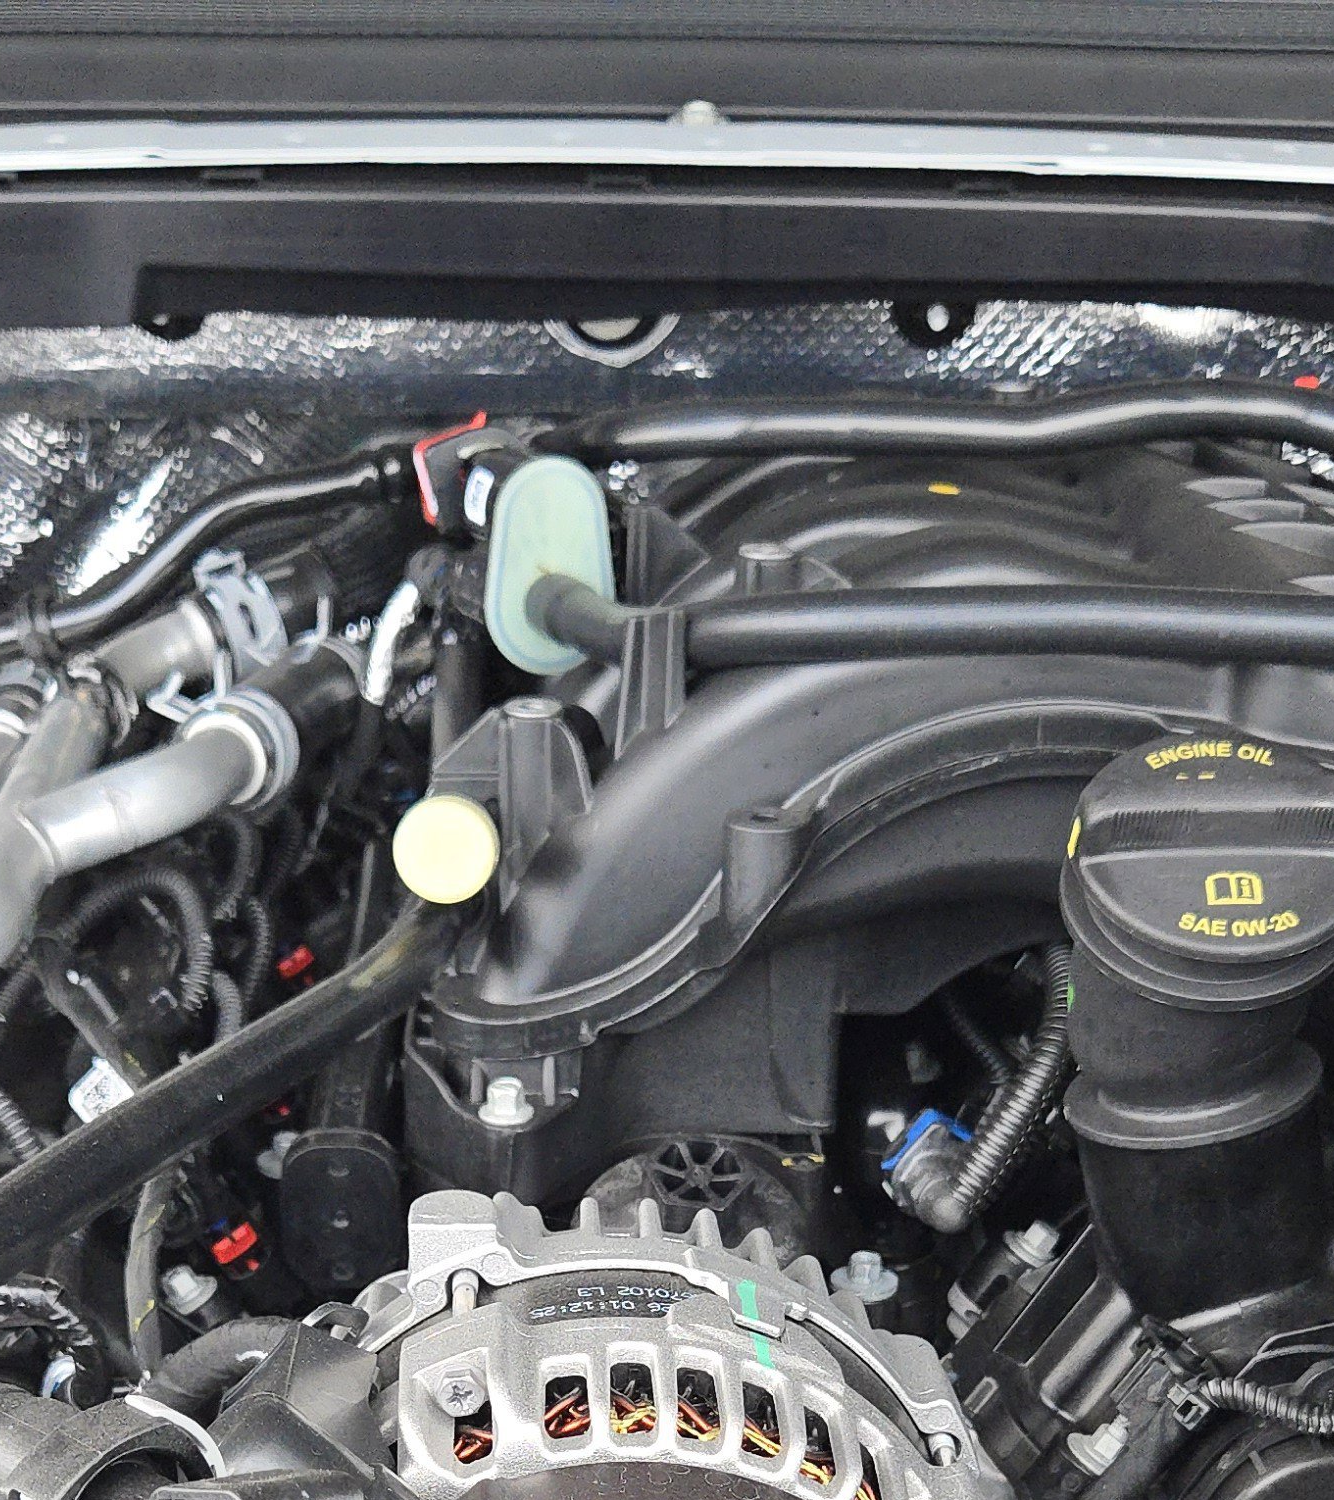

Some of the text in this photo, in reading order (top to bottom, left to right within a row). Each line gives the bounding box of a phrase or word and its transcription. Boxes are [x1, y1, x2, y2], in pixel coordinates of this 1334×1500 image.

[1145, 741, 1275, 770] ENGINE OIL
[1178, 911, 1300, 937] SAE 0W-20
